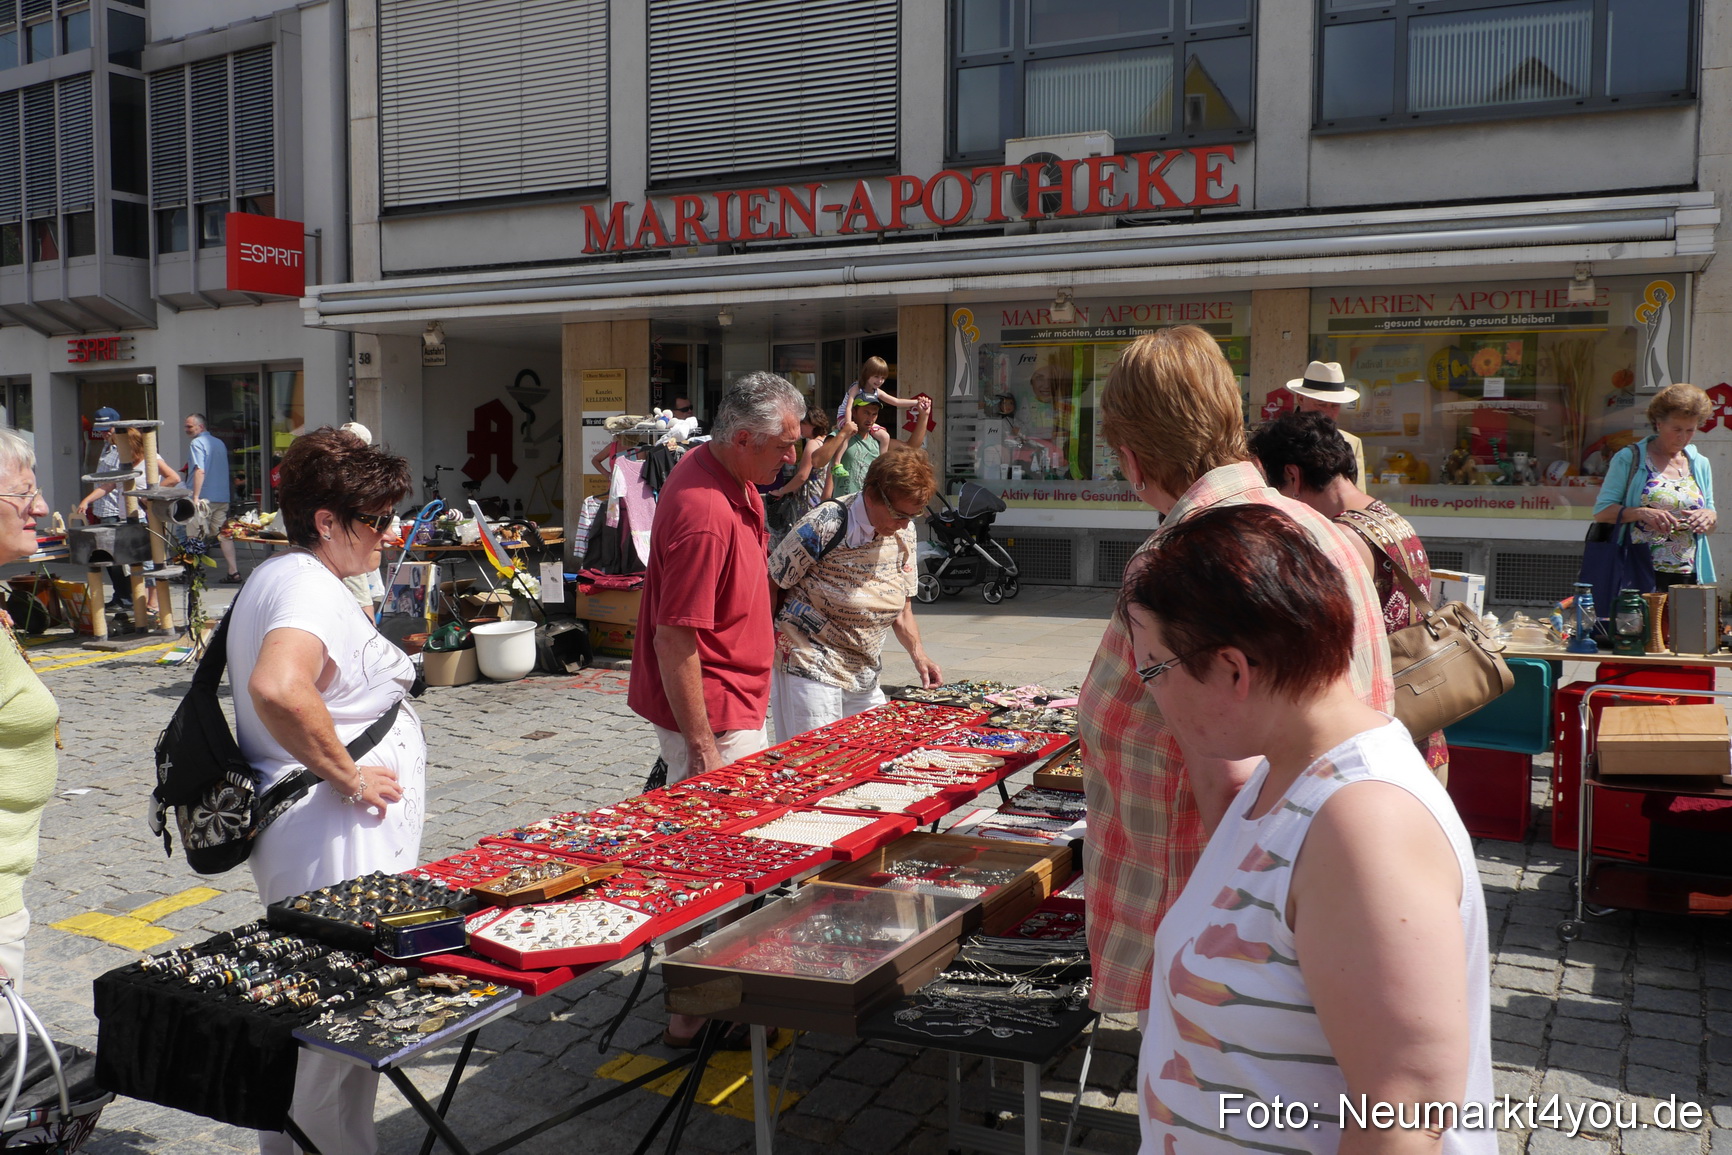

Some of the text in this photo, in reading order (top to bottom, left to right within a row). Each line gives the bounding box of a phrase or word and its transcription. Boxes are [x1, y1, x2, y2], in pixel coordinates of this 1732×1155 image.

[580, 145, 1239, 254] MARIEN-APOTHEKE
[240, 242, 303, 268] ESPRIT
[1328, 287, 1611, 315] MARIEN APOTHEE
[1001, 302, 1234, 326] MARN APOTHEKE
[1424, 316, 1466, 327] werden,
[1469, 315, 1508, 327] gesund
[1511, 313, 1555, 325] bleiben!
[1054, 326, 1093, 338] möchten,
[1095, 326, 1115, 336] dass
[1116, 328, 1127, 336] es
[1129, 325, 1154, 336] Ihnen
[68, 337, 121, 363] ESPRIT
[424, 347, 445, 356] Ausfahrt
[358, 352, 371, 365] 38
[1017, 353, 1038, 366] frei
[1001, 489, 1029, 501] Aktiv
[1032, 489, 1051, 501] für
[1053, 489, 1077, 501] Ihre
[1410, 494, 1438, 508] Ihre
[1519, 494, 1554, 510] hilft.
